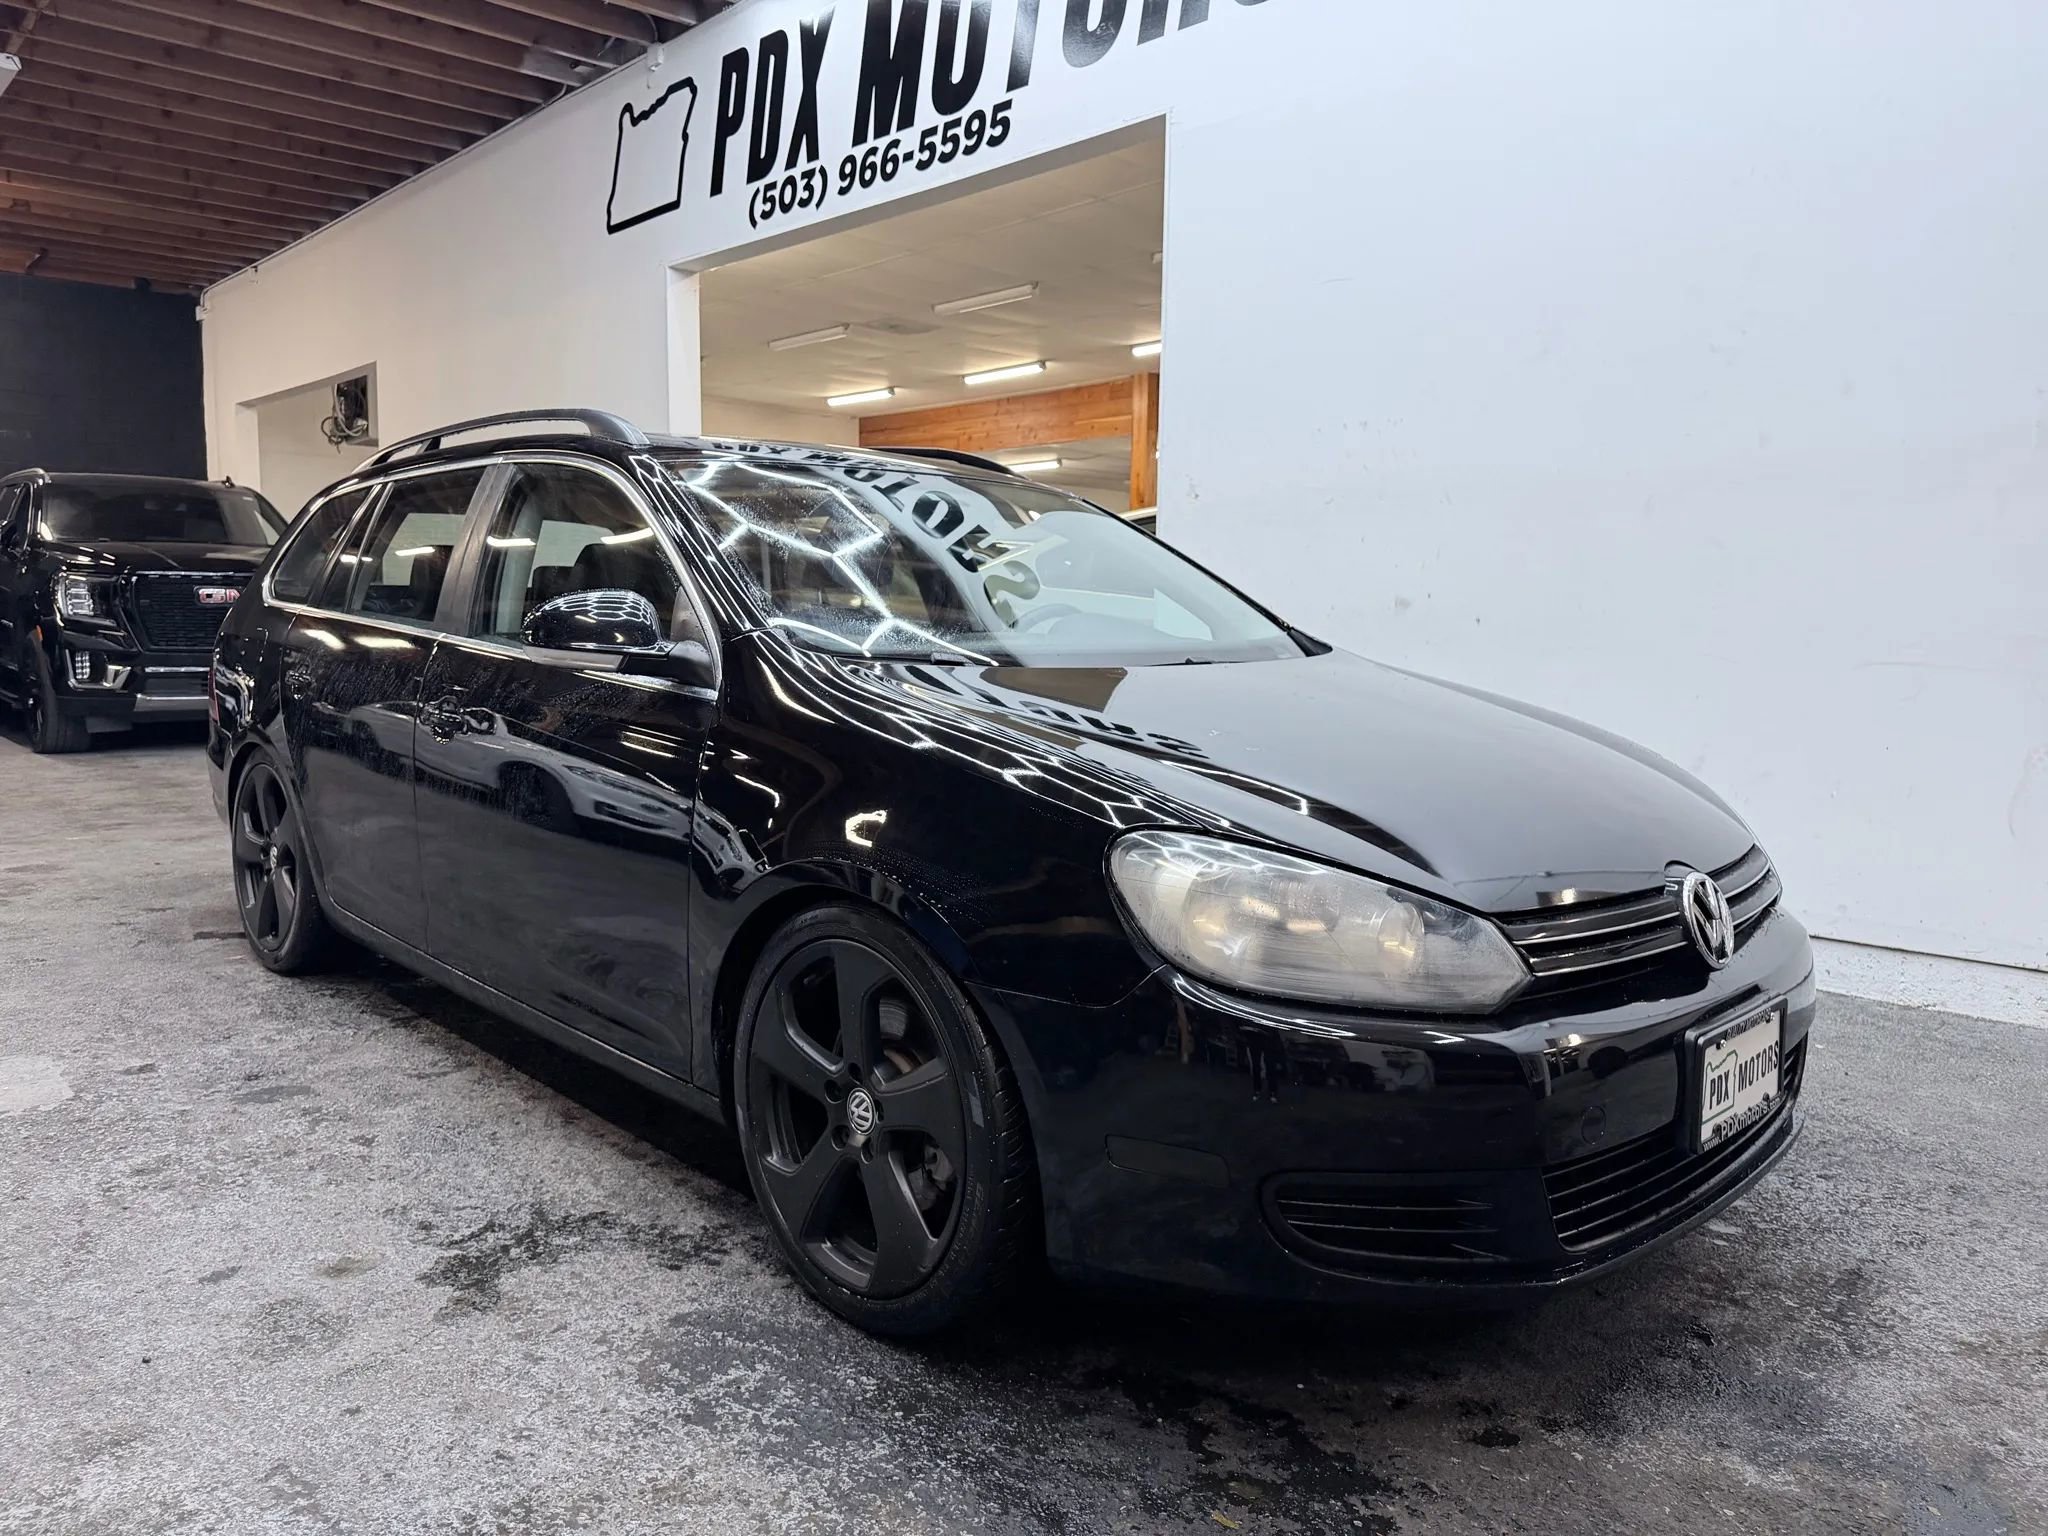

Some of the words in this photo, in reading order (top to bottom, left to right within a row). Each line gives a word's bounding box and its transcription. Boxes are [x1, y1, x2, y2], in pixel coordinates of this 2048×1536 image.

[709, 5, 836, 198] PDX
[748, 166, 828, 230] (503)
[837, 99, 1014, 196] 966-5595
[1709, 1069, 1731, 1111] PDX
[1738, 1040, 1779, 1094] MOTORS
